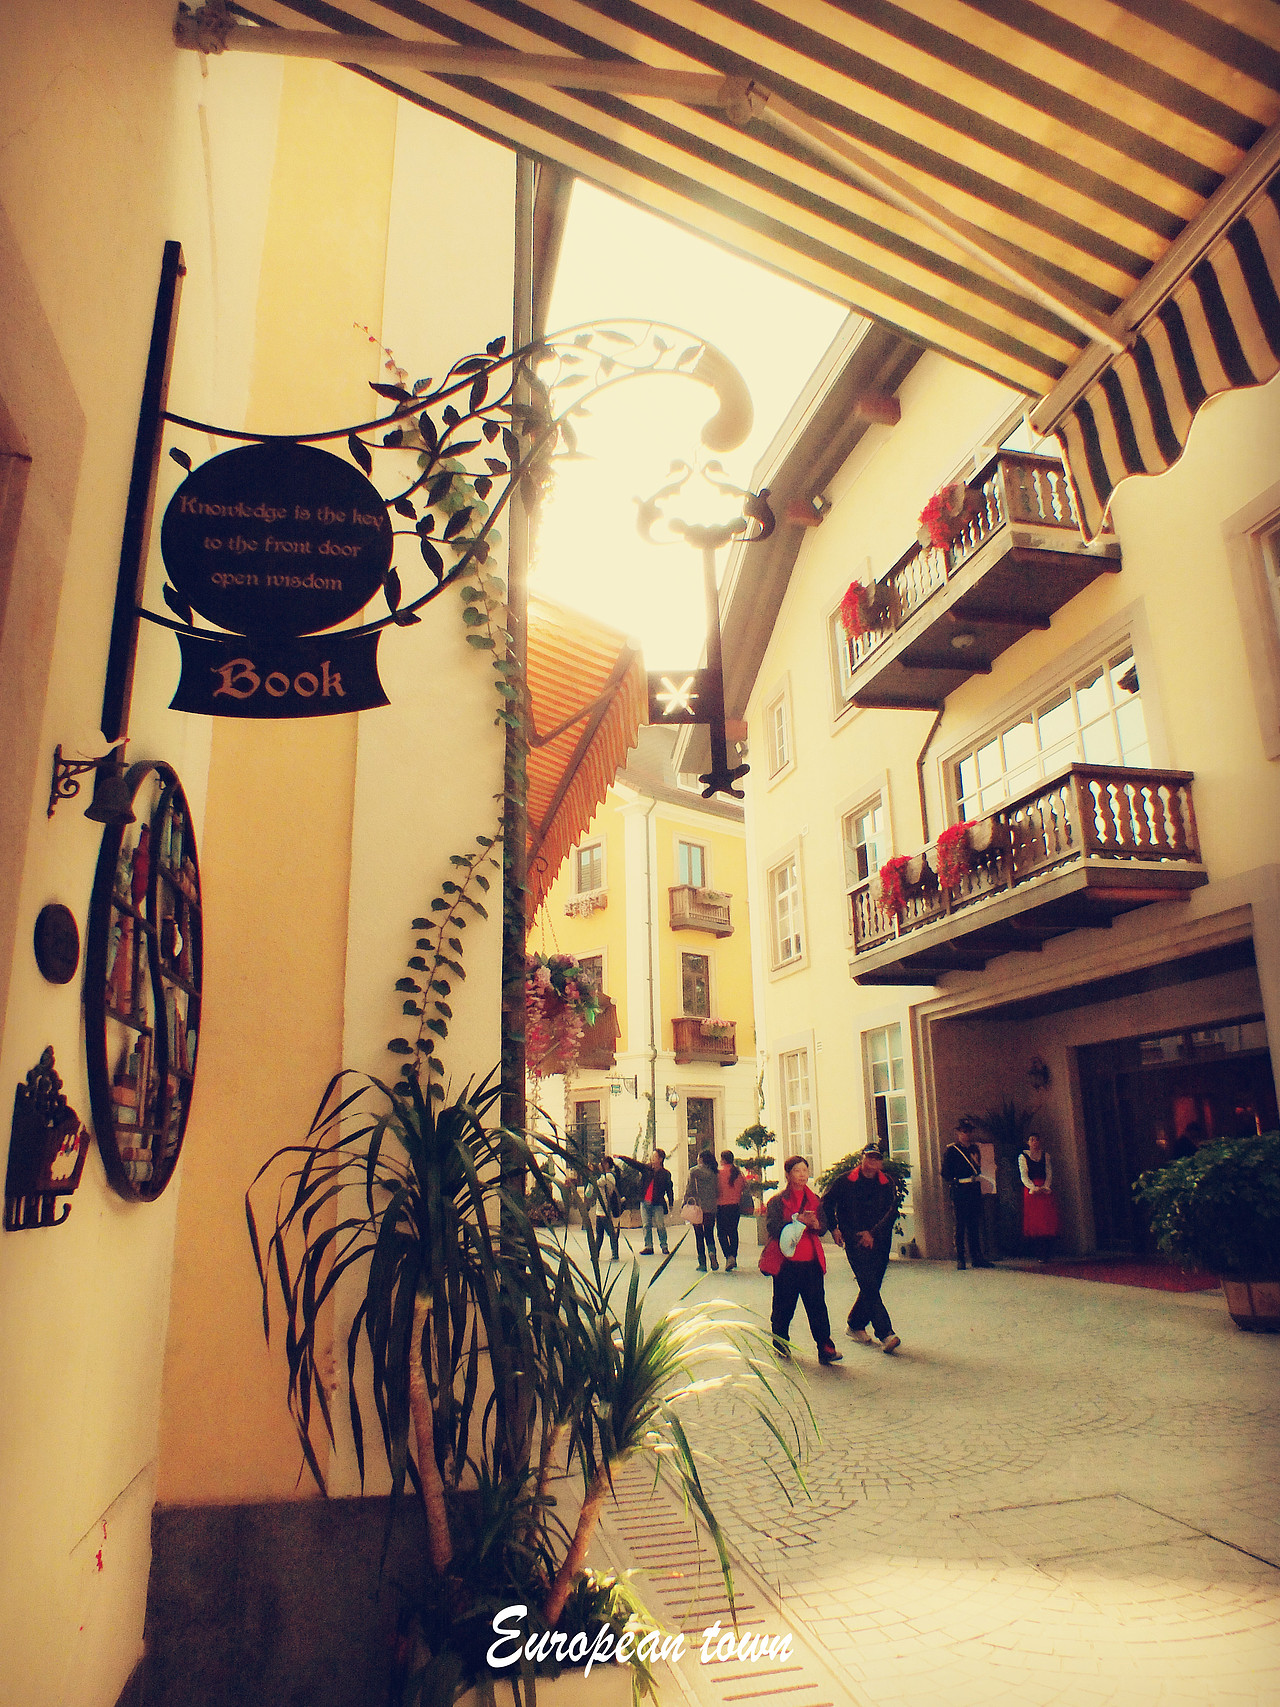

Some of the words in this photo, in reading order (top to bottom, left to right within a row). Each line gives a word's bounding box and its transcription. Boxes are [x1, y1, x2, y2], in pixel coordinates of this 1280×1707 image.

[180, 495, 287, 523] Knowledge
[294, 504, 311, 521] is
[317, 506, 346, 525] the
[352, 508, 384, 531] key
[203, 536, 222, 550] to
[228, 535, 258, 555] the
[264, 536, 312, 554] front
[318, 539, 362, 557] door
[211, 572, 259, 589] open
[266, 573, 343, 591] wisdom
[210, 658, 347, 699] Book
